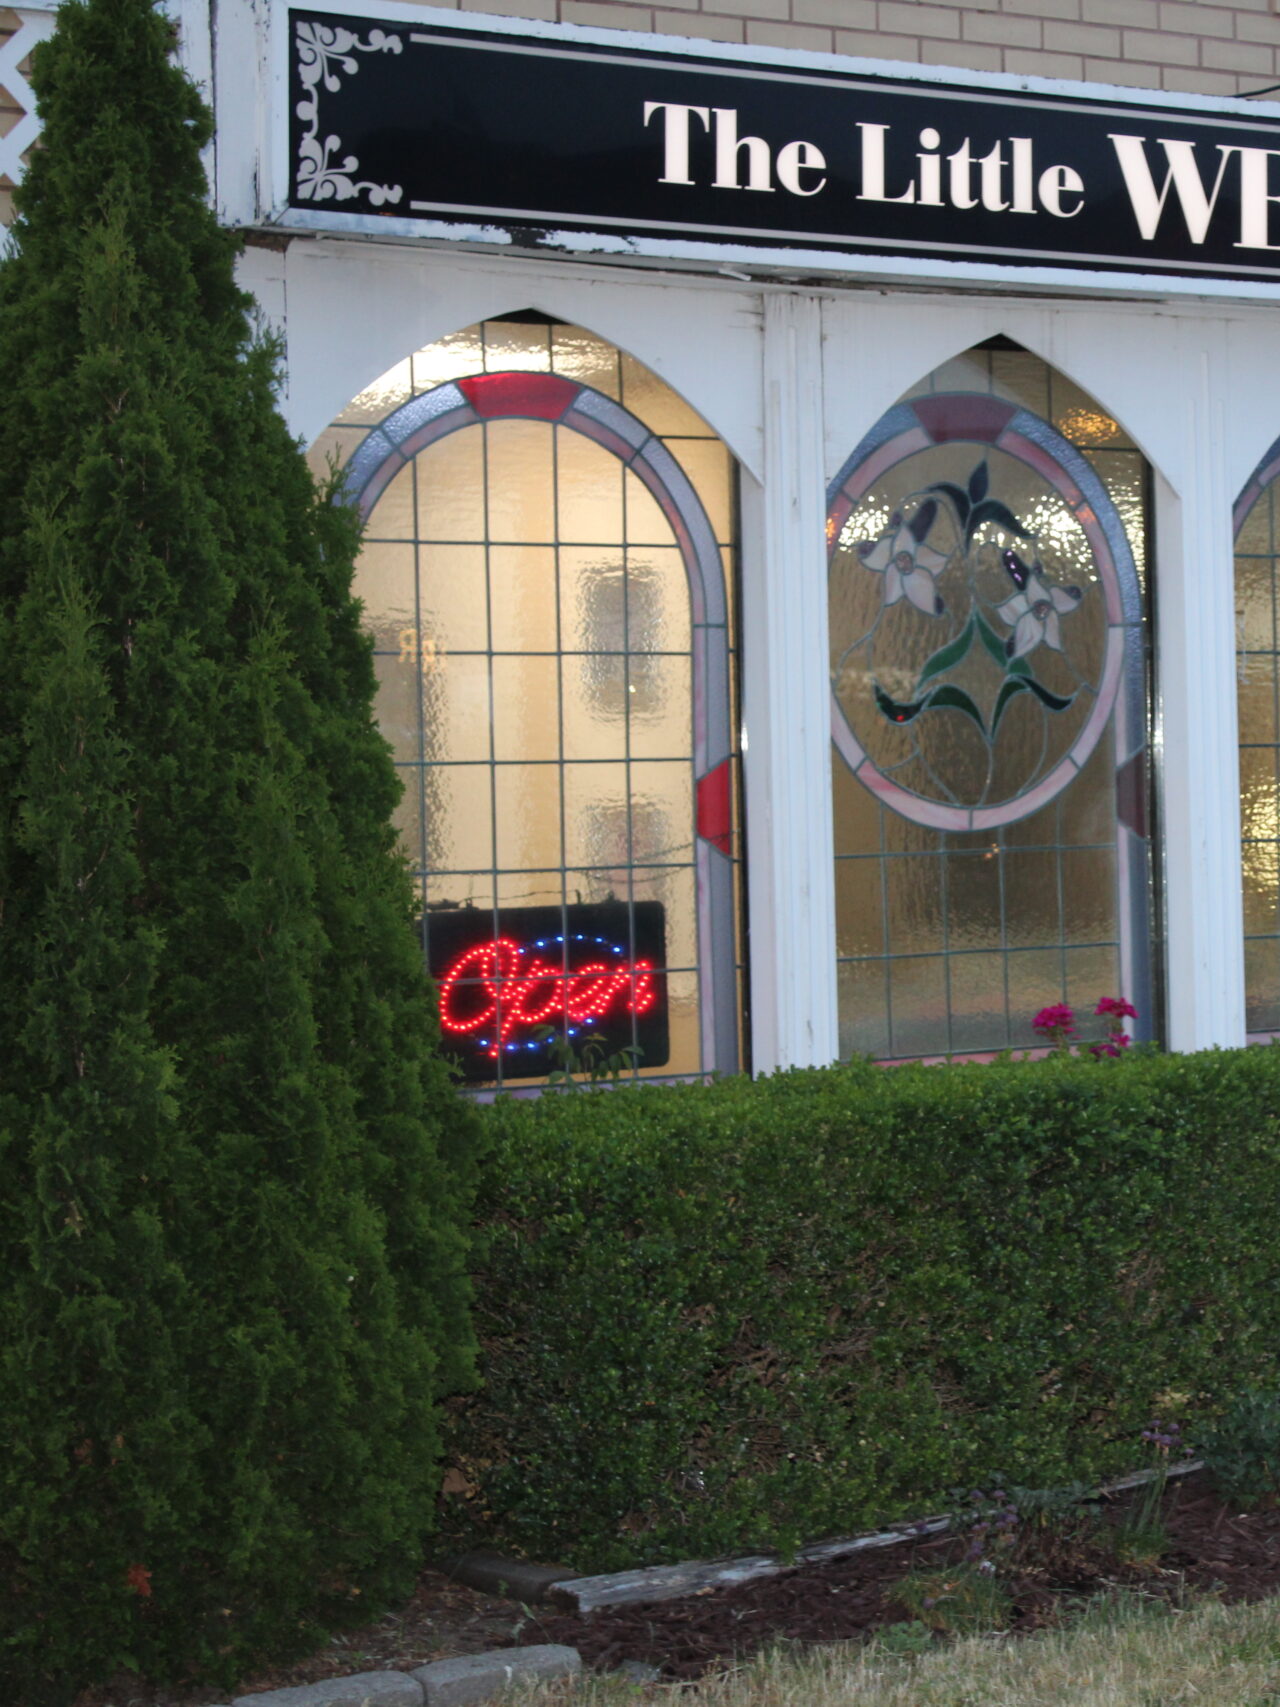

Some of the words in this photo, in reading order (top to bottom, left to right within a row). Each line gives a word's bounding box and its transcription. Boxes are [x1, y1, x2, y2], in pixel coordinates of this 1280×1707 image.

[644, 102, 826, 196] The
[856, 123, 1084, 217] Little
[440, 937, 655, 1058] Open
